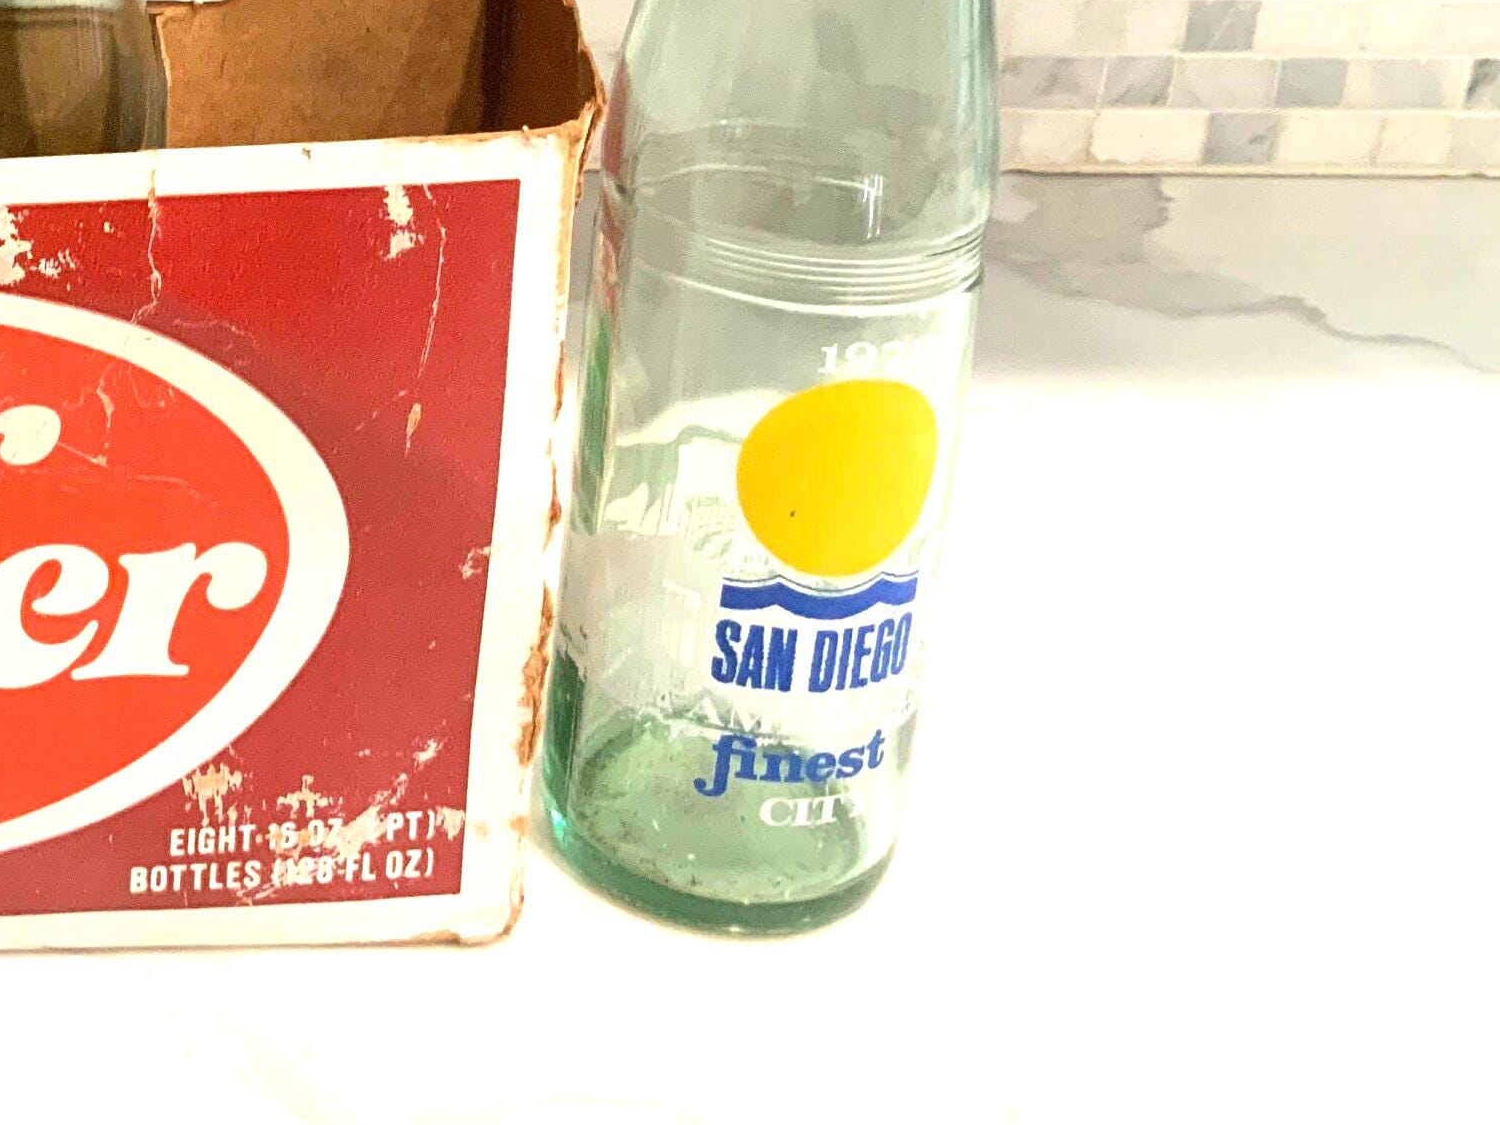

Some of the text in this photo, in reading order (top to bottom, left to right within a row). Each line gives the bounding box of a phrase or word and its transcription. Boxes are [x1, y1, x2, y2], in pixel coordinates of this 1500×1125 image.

[817, 339, 938, 375] 197
[710, 611, 912, 694] SAN DIEGO
[693, 728, 886, 797] finest
[168, 823, 257, 857] EIGHT
[129, 860, 261, 894] BOTTLES
[344, 853, 378, 883] FL
[385, 847, 435, 880] OZ)
